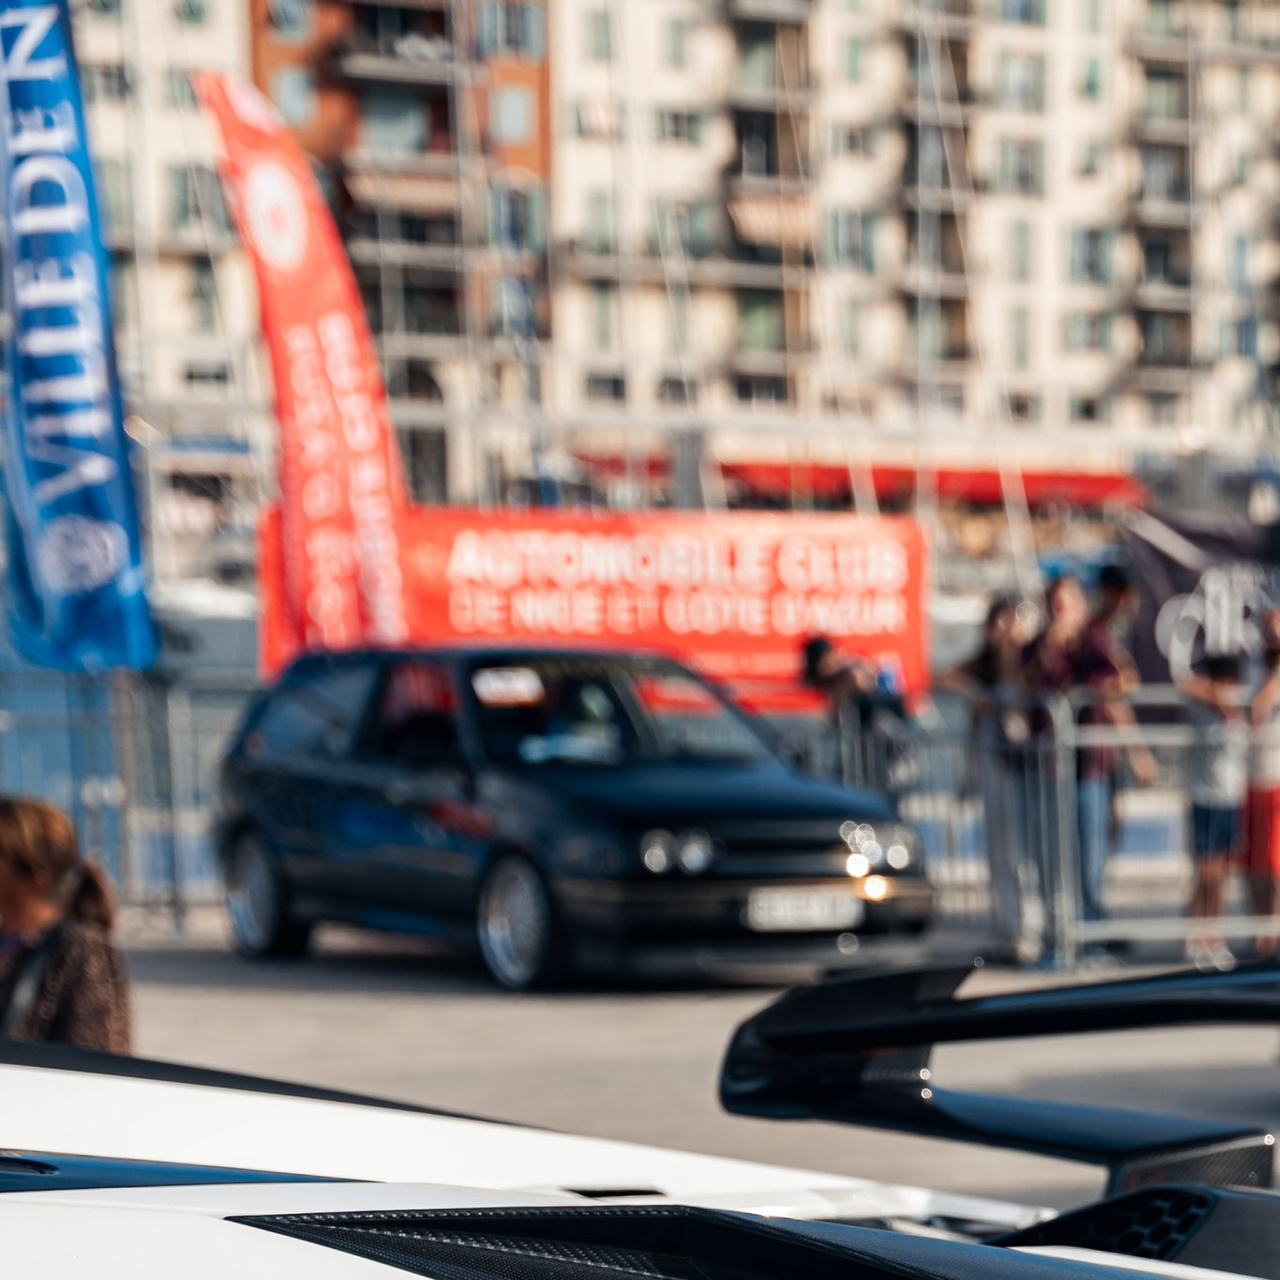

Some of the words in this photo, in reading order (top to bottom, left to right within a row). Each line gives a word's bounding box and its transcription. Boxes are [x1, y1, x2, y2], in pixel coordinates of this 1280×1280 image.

[5, 98, 90, 235] DE
[11, 252, 117, 503] VILLE
[446, 529, 777, 586] AUTOMOBILE
[777, 535, 908, 590] CLUB
